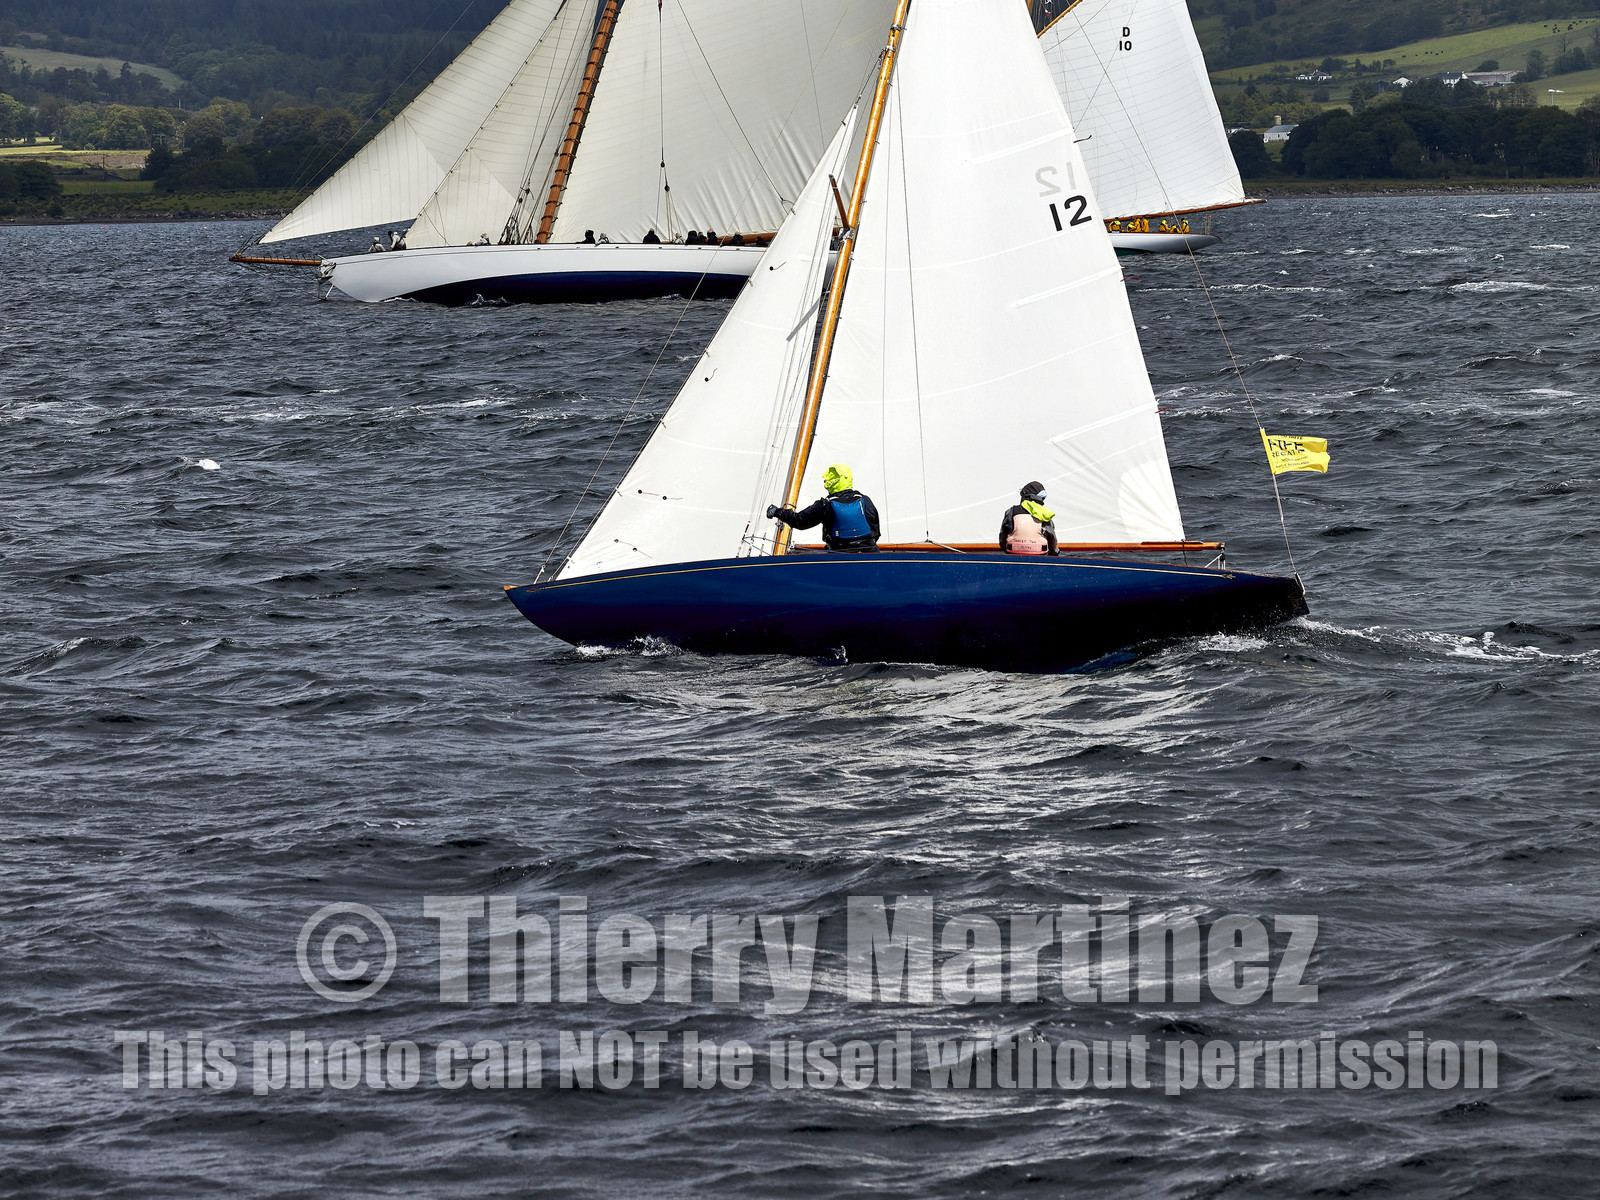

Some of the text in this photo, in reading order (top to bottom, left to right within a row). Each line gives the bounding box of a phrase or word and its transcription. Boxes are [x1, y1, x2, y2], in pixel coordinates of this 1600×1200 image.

[1122, 26, 1131, 38] D
[1119, 40, 1132, 52] 10
[1048, 194, 1093, 232] 12
